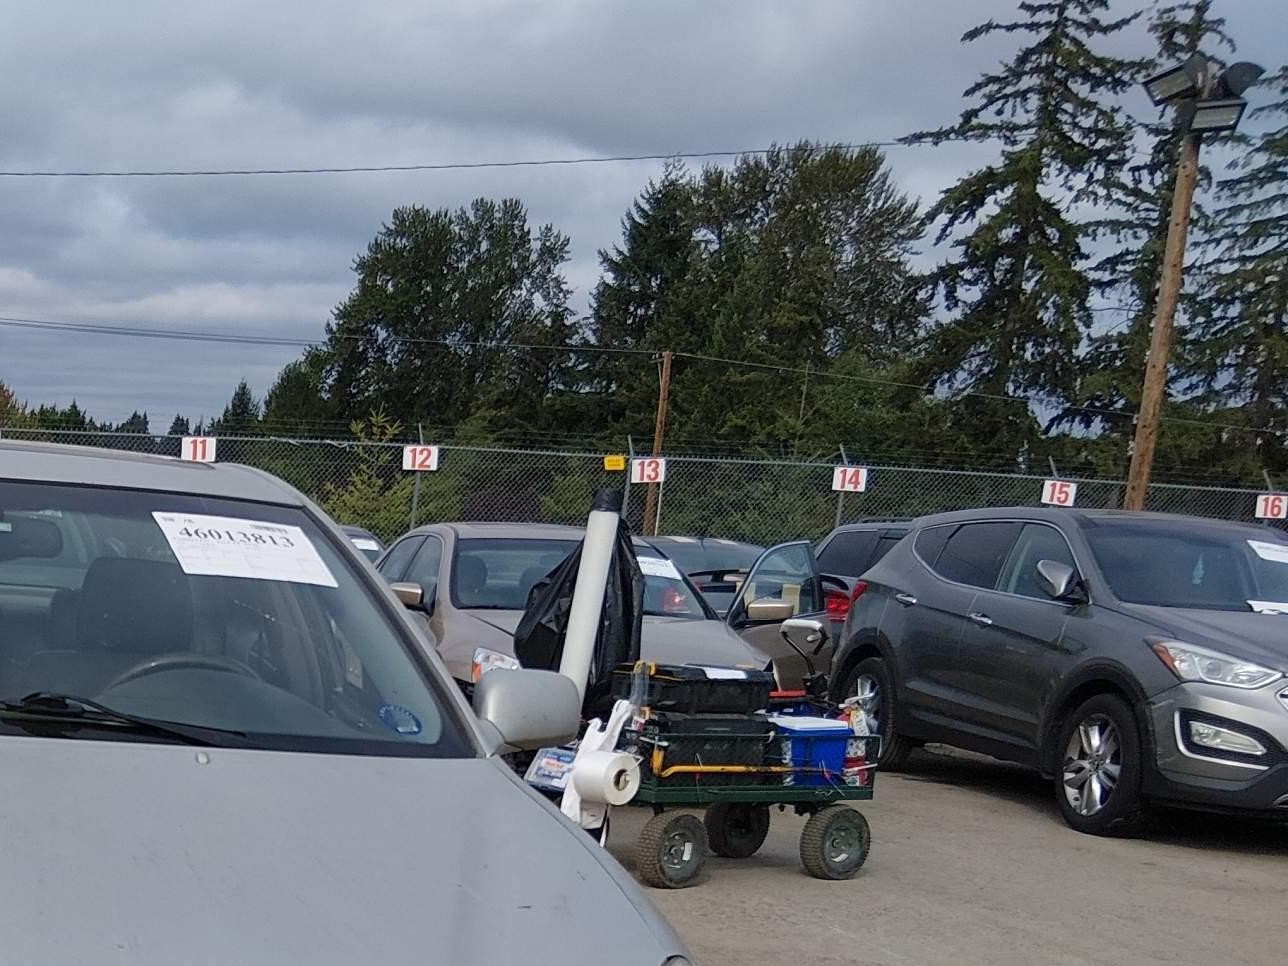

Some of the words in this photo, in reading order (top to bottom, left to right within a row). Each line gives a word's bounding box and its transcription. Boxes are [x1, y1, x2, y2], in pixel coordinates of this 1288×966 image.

[190, 439, 207, 461] 11
[409, 447, 432, 469] 12
[638, 460, 660, 481] 13
[840, 468, 861, 490] 14
[1048, 482, 1071, 504] 15
[1263, 496, 1283, 517] 16
[179, 526, 295, 548] 46013813
